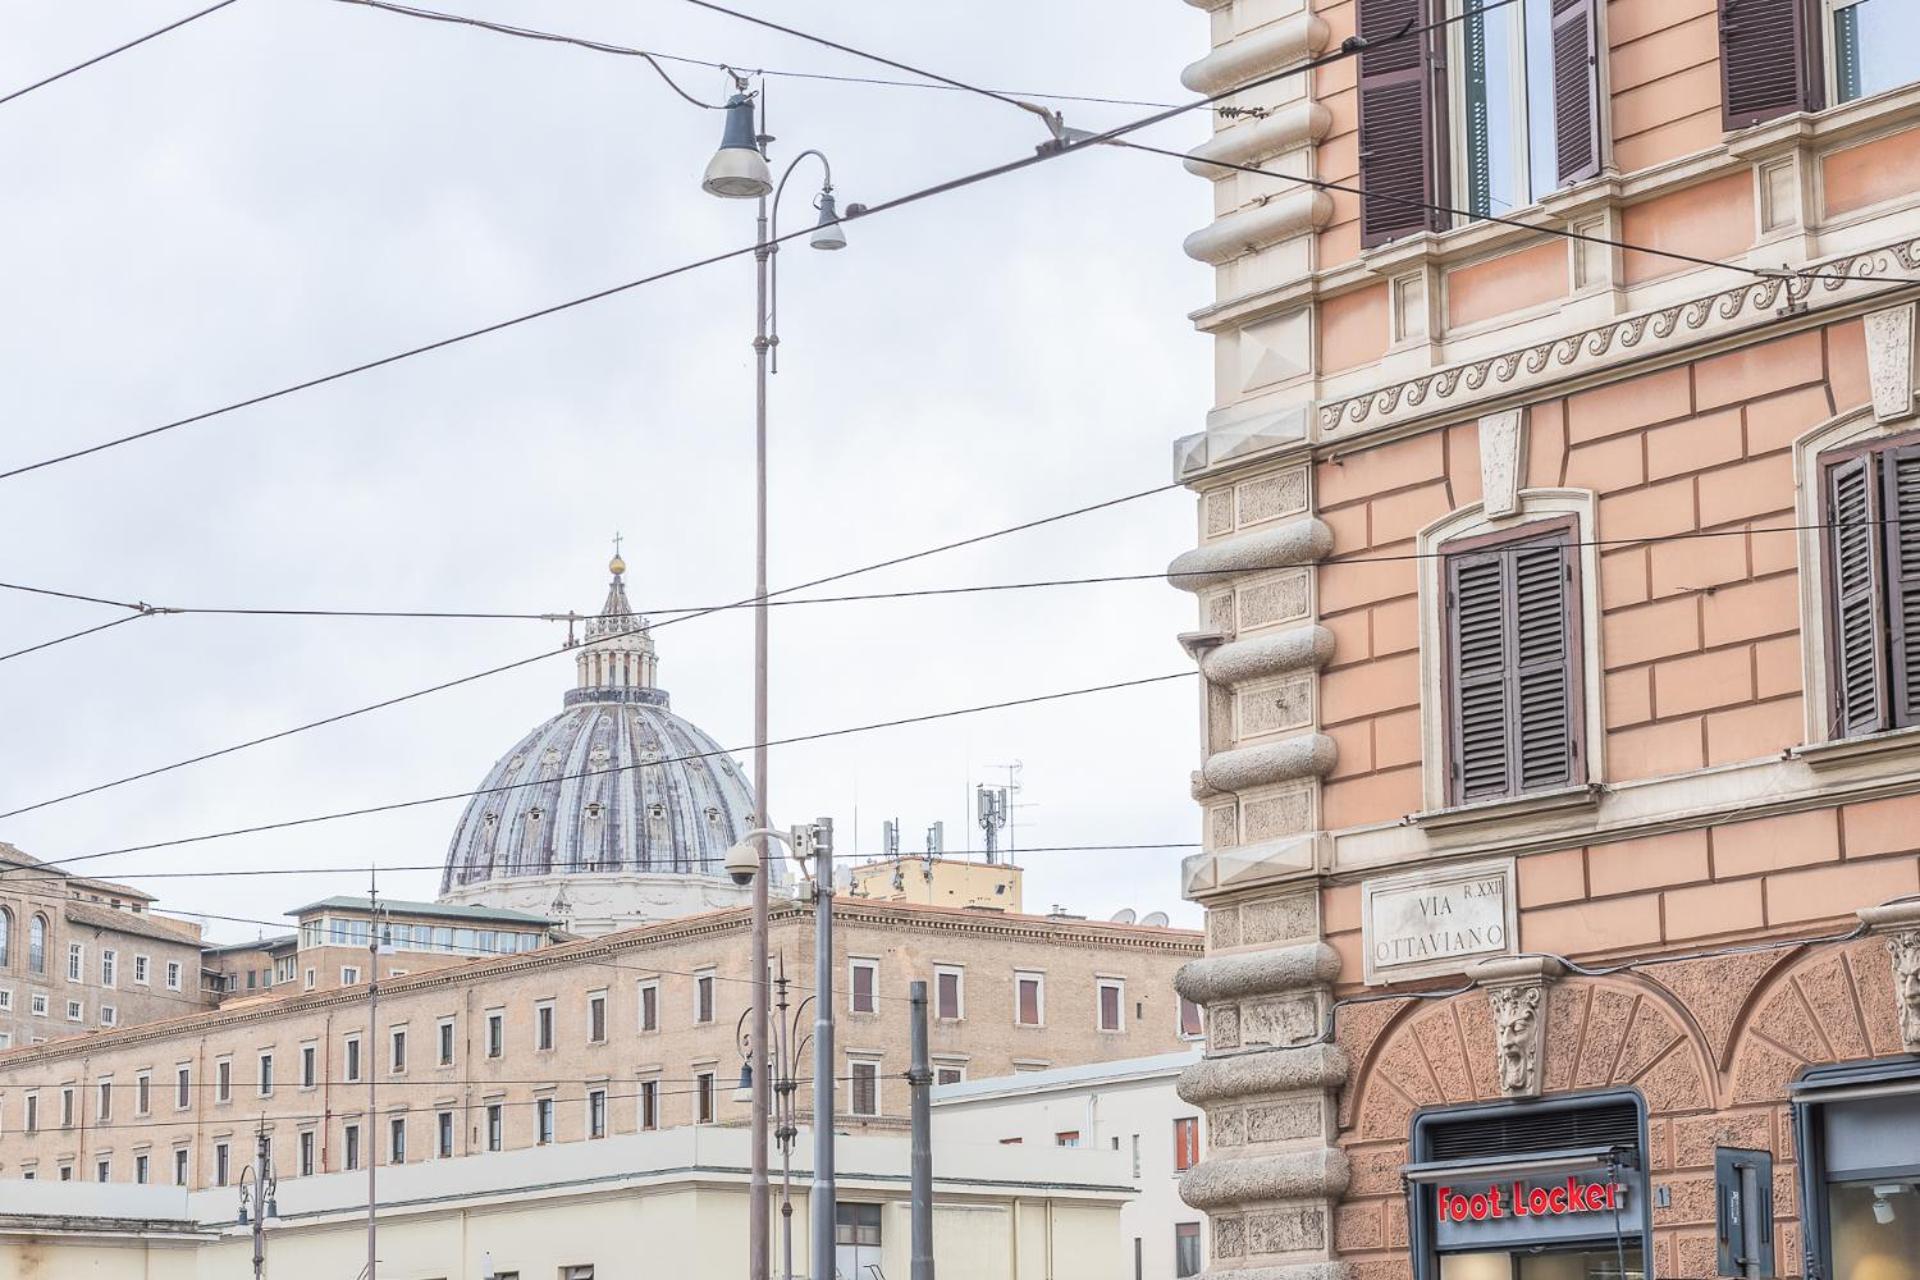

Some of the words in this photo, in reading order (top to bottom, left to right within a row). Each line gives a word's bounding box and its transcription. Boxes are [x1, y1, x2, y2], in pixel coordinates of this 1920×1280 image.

[1419, 896, 1452, 916] VIA
[1376, 924, 1502, 961] OTTAVIANO
[1437, 1184, 1502, 1222] Foot
[1512, 1175, 1620, 1217] Locker
